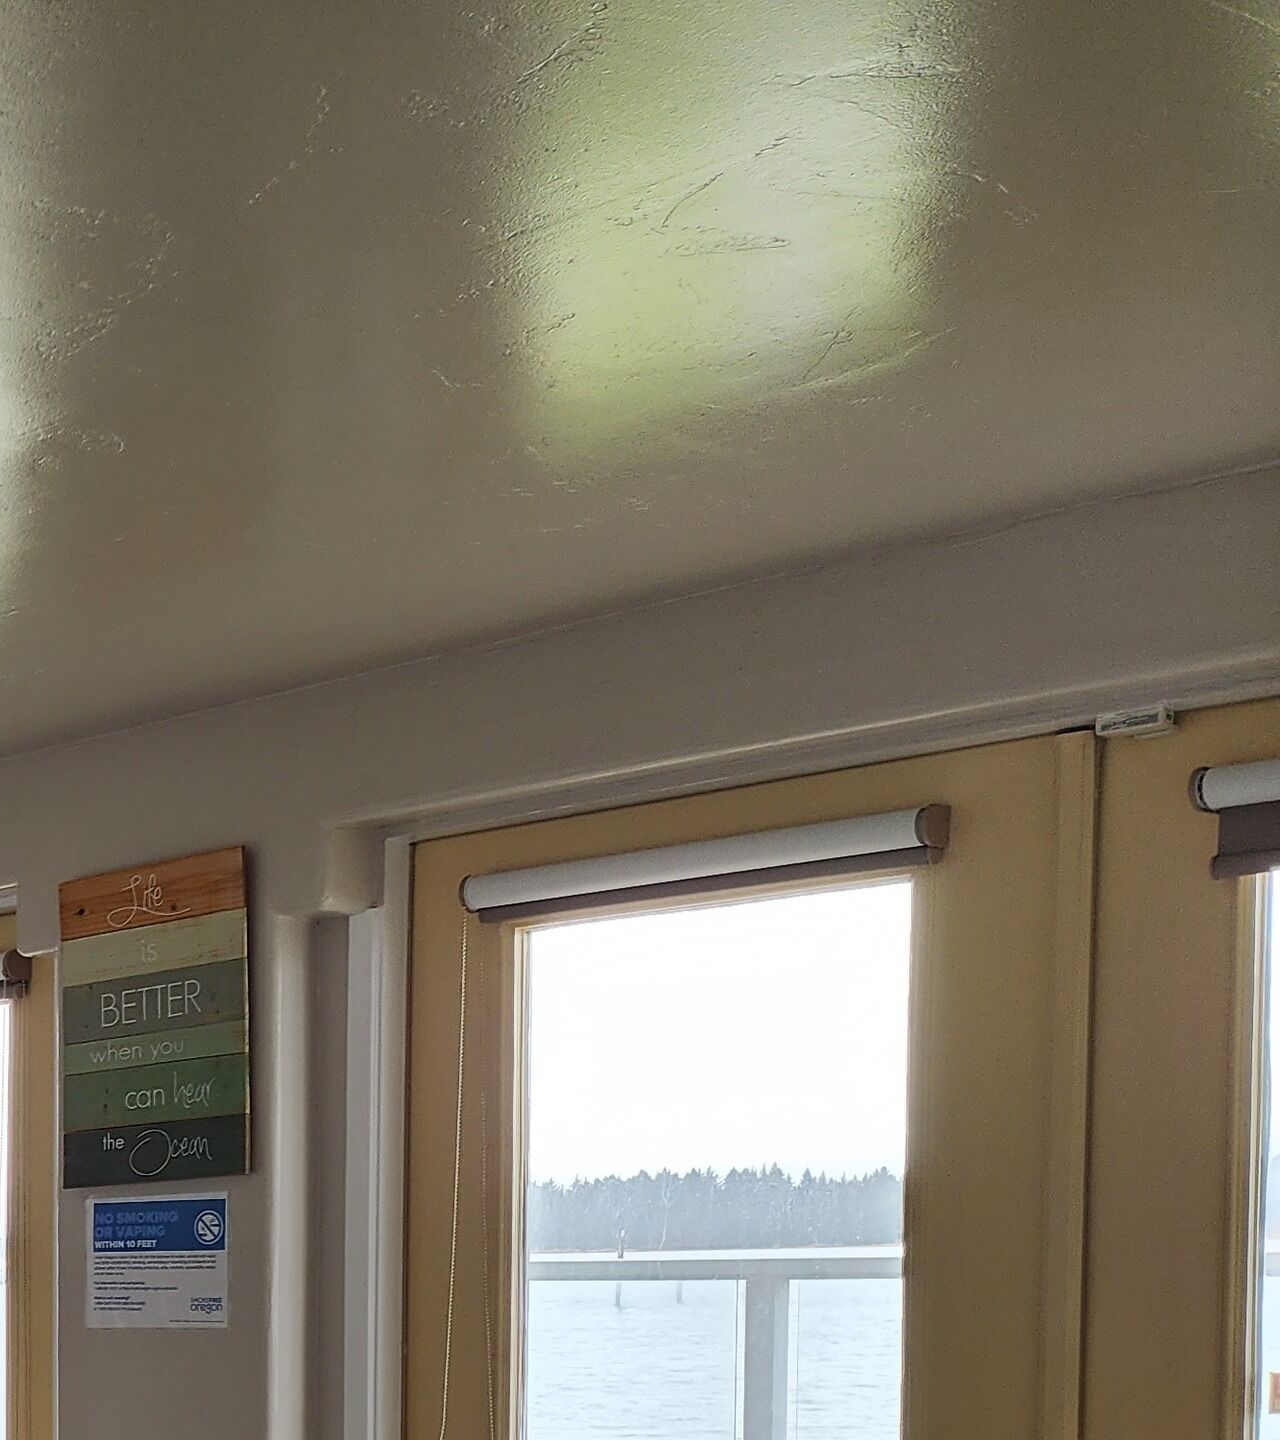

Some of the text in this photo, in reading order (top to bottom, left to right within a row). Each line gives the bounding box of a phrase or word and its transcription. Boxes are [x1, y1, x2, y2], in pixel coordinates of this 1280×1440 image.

[107, 874, 191, 927] Life
[141, 940, 157, 963] is
[100, 979, 201, 1028] BETTER
[90, 1037, 184, 1065] when you
[125, 1071, 215, 1111] can hear
[102, 1129, 212, 1176] the Ocean
[95, 1225, 166, 1238] OR VAPING
[96, 1210, 178, 1225] NO SMOKING
[95, 1240, 157, 1249] WITHIN 10 FEET
